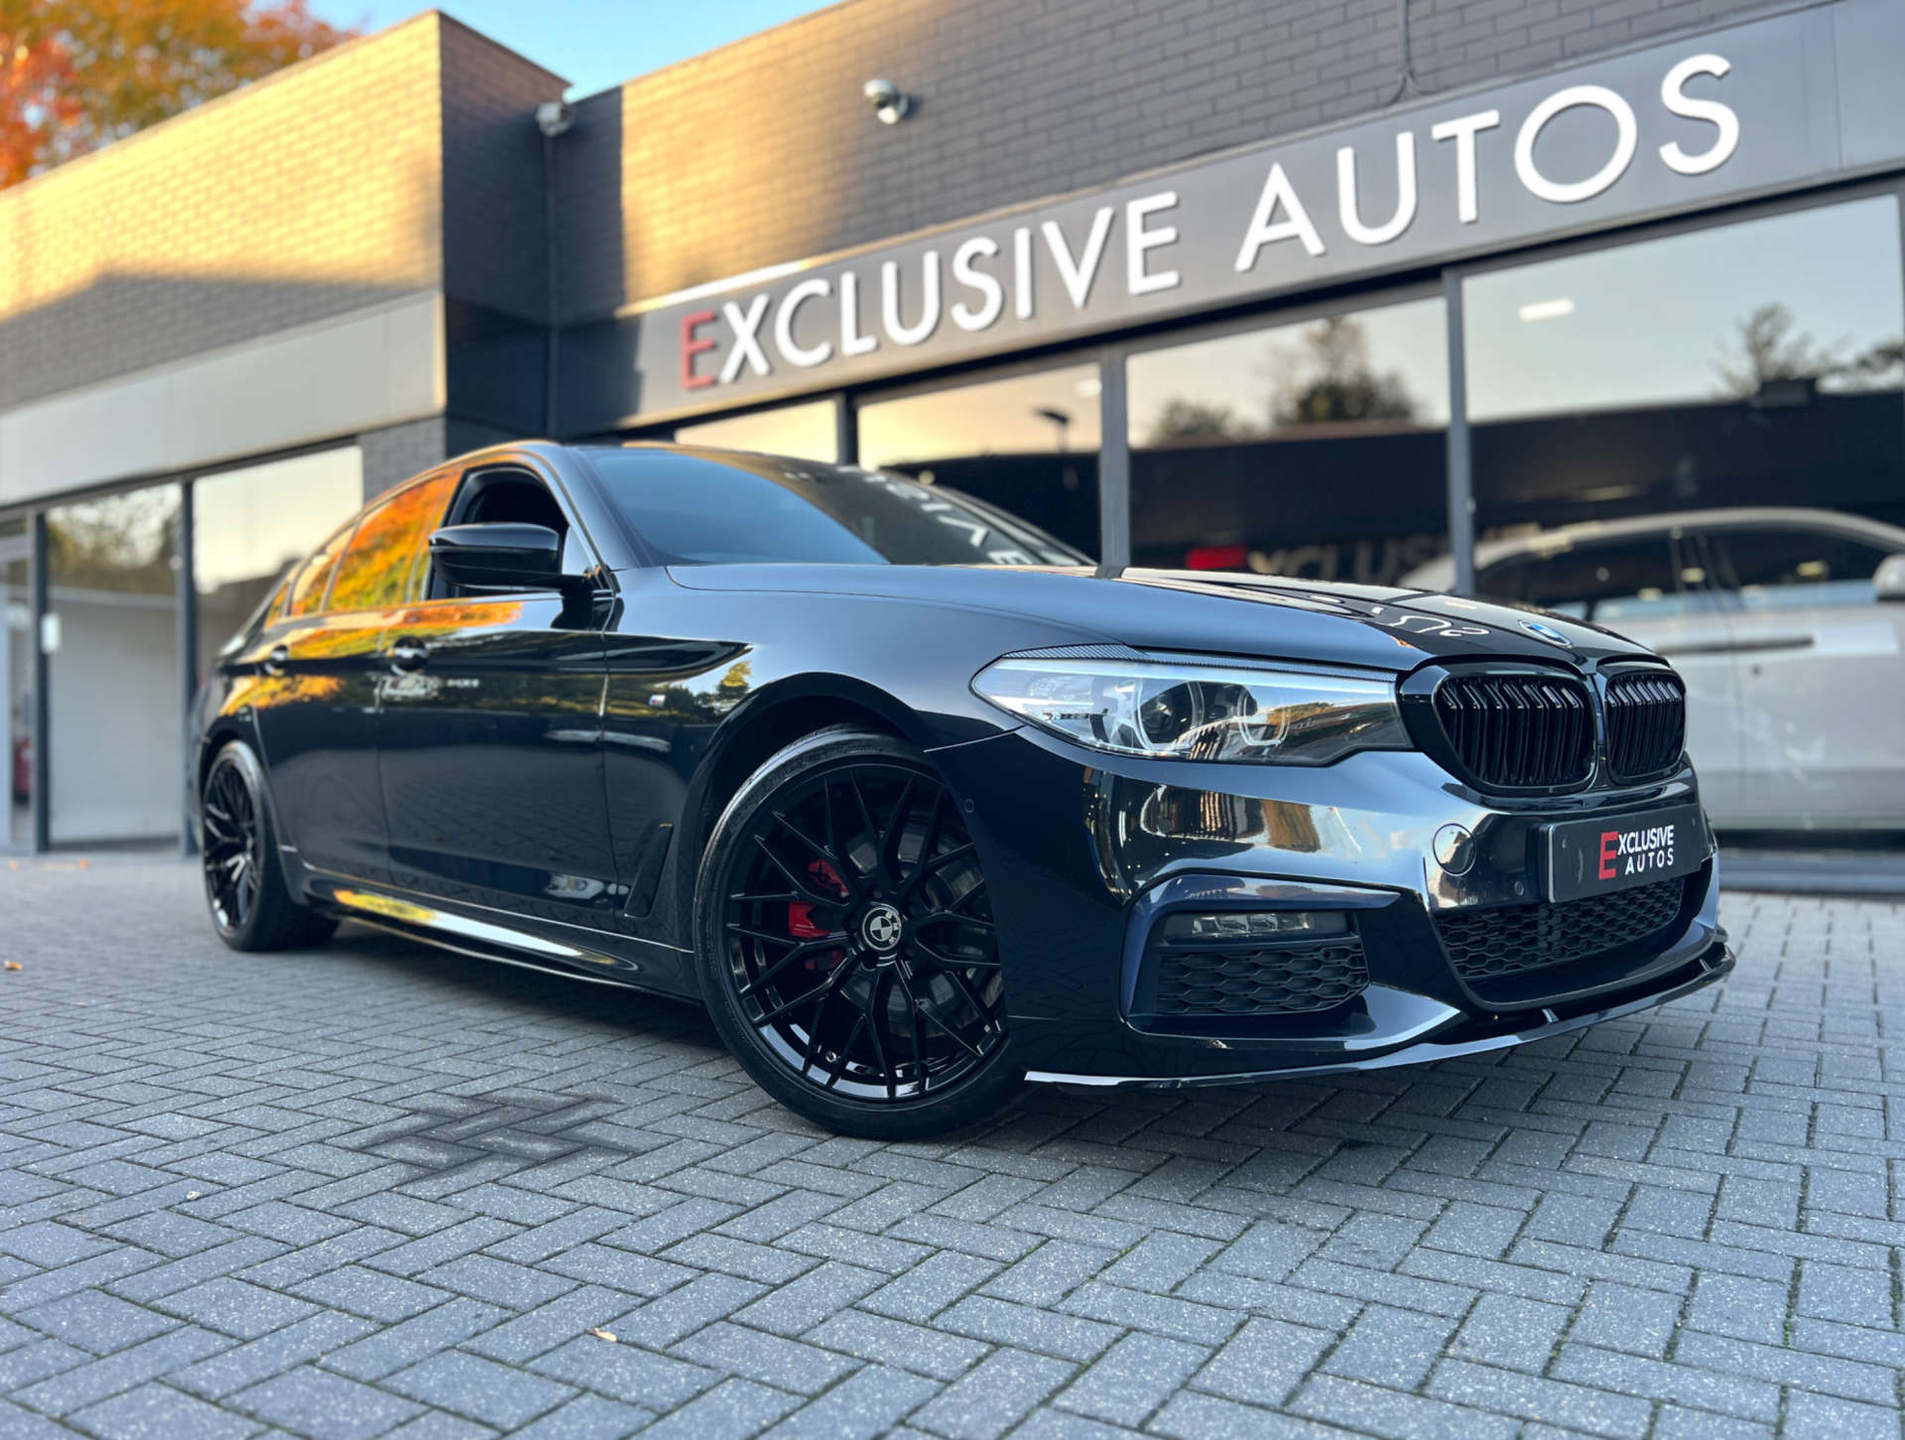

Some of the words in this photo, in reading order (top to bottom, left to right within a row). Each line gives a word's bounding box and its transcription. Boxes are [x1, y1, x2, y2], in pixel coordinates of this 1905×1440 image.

[679, 191, 1180, 391] EXCLUSIVE
[1233, 53, 1741, 272] AUTOS
[1598, 825, 1674, 880] EXCLUSIVE
[1624, 848, 1674, 875] AUTOS
